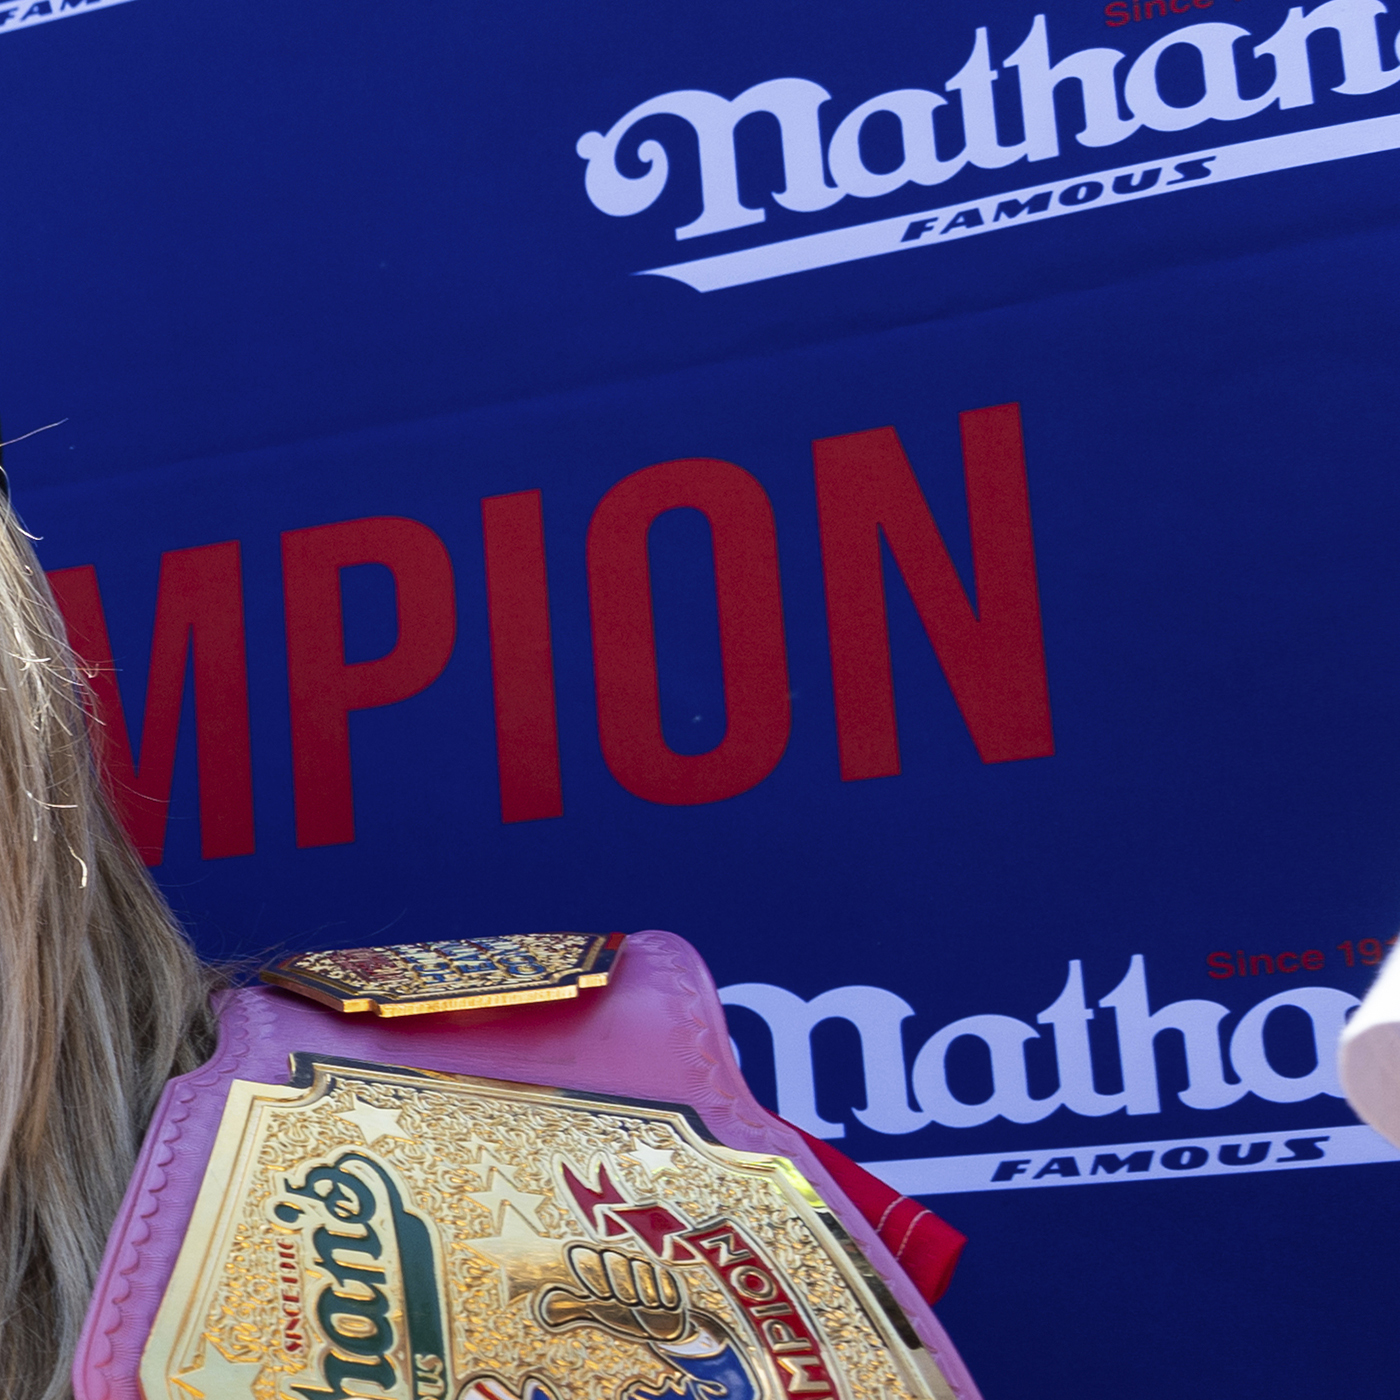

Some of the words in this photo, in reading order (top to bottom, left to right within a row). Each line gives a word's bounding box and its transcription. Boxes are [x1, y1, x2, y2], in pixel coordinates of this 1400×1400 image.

[576, 0, 1400, 241] Nathan
[899, 155, 1218, 244] FAMOUS
[43, 402, 1056, 868] MPION
[1206, 949, 1326, 980] Since
[1336, 935, 1400, 968] 19
[710, 953, 1366, 1141] Natha
[989, 1136, 1331, 1183] FAMOUS
